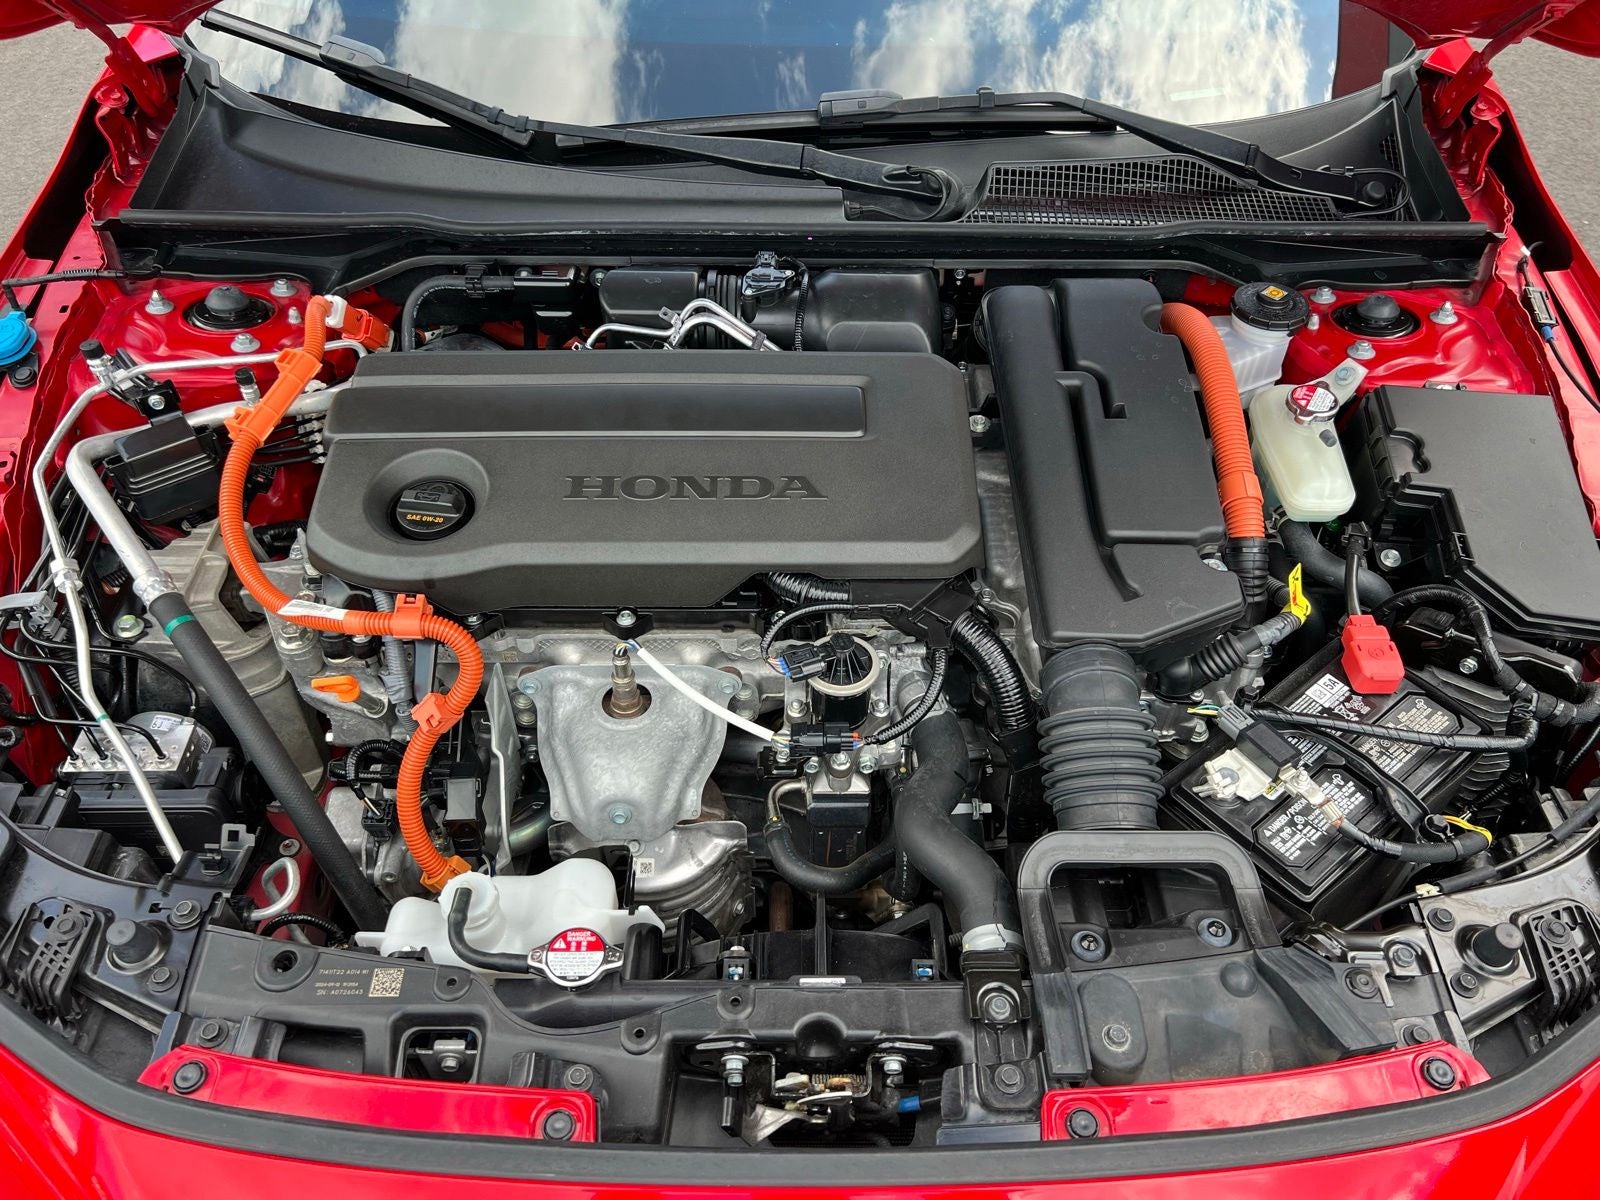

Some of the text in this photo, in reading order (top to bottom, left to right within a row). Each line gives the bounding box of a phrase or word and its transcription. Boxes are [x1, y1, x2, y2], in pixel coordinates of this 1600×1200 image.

[563, 475, 829, 501] HONDA
[422, 515, 444, 524] 0W-20
[1323, 678, 1340, 690] 5A
